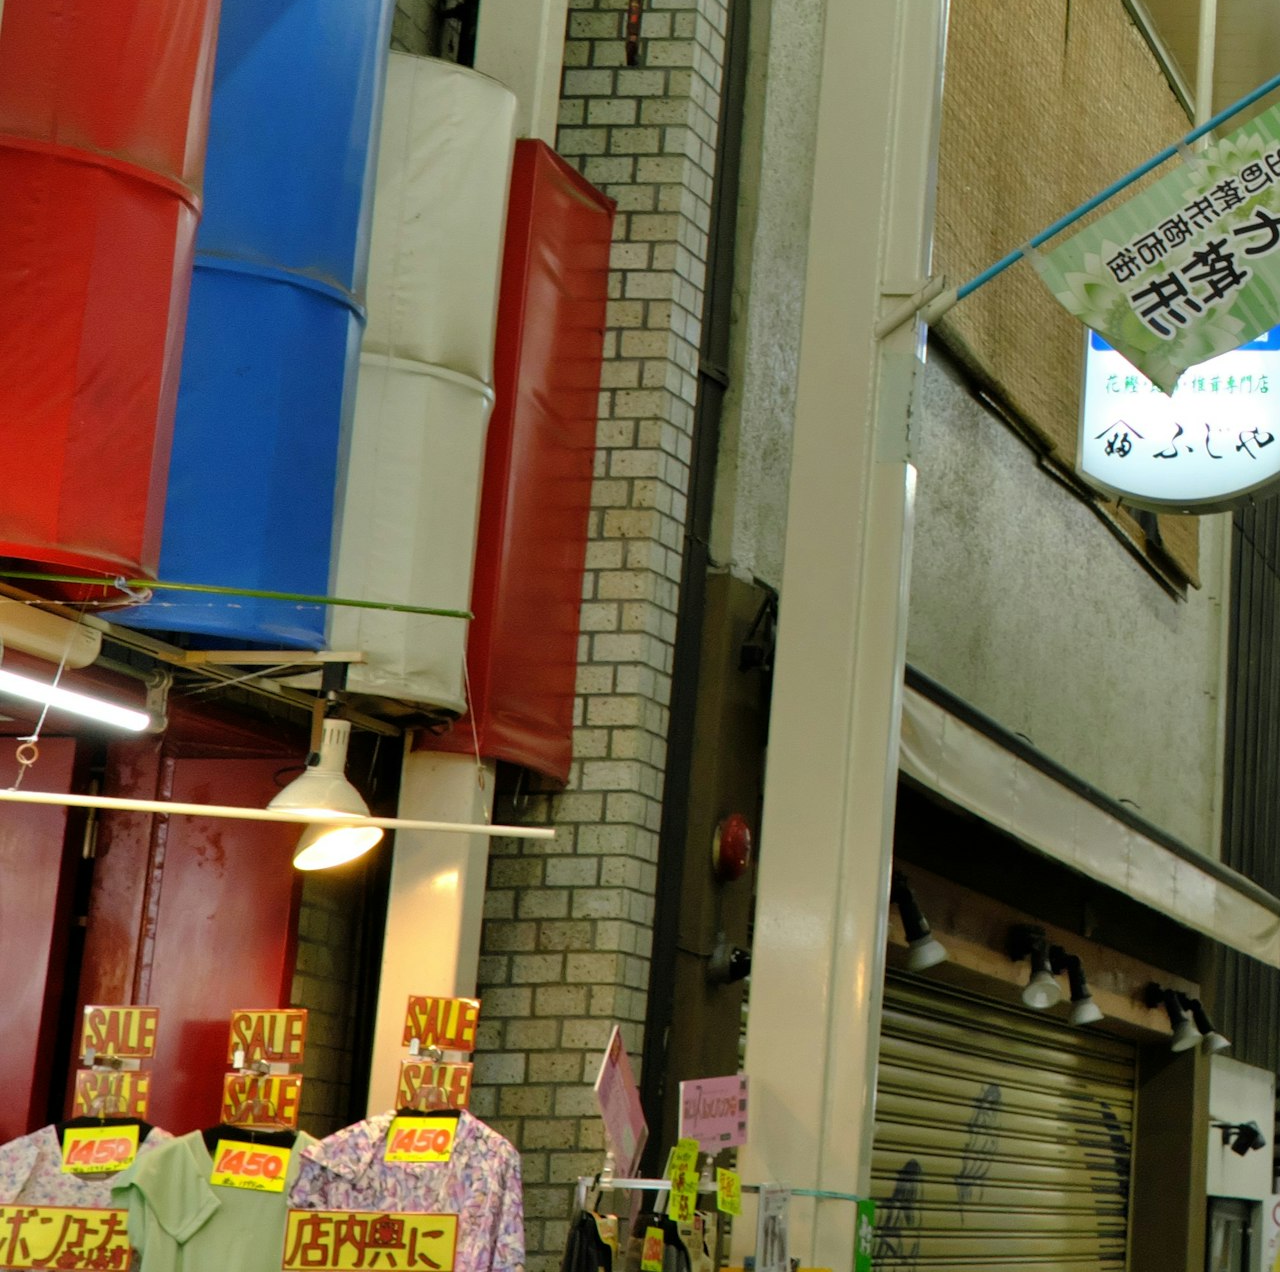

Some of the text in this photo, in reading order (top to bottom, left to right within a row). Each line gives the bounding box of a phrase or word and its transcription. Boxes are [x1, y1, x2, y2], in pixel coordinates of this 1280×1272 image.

[86, 1010, 156, 1057] SALE
[232, 1014, 303, 1062] SALE
[404, 997, 480, 1050] SALE
[78, 1071, 148, 1118] SALE
[224, 1078, 300, 1124] SALE
[400, 1064, 468, 1109] SALE
[66, 1138, 132, 1165] 1450
[216, 1149, 283, 1178] 1450
[389, 1129, 450, 1154] 1450
[0, 1209, 128, 1266] ボンコーナー
[286, 1213, 444, 1268] 店内奥に
